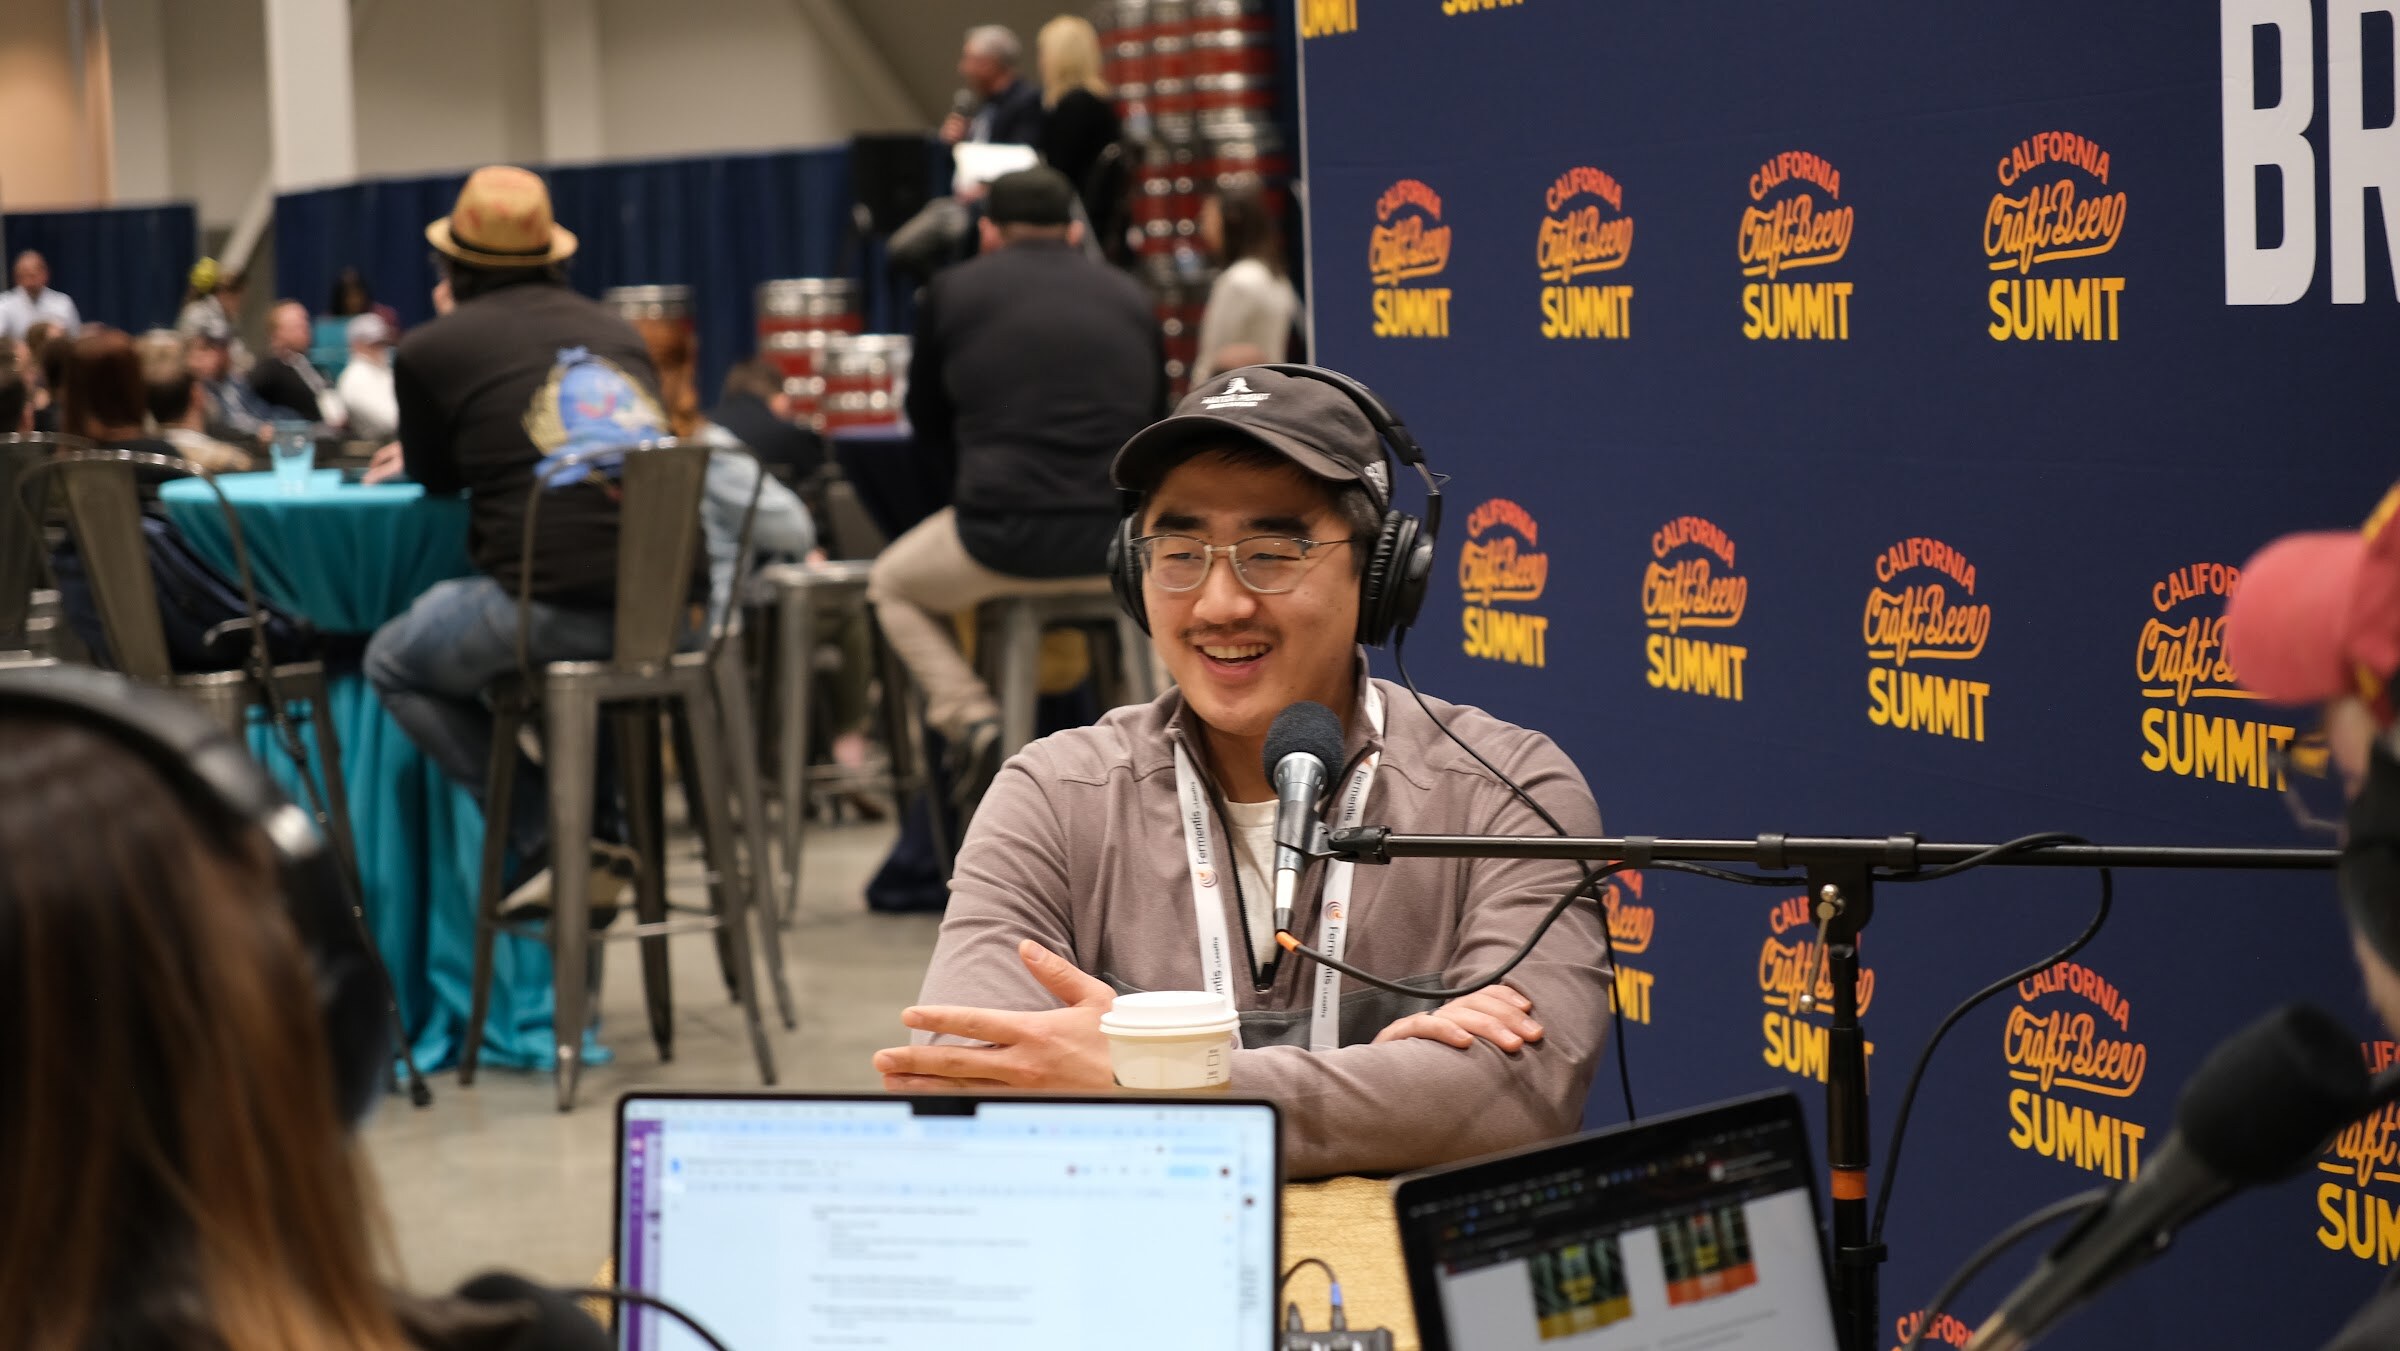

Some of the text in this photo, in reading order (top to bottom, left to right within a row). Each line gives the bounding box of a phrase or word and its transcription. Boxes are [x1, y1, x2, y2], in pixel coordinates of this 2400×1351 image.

[1546, 166, 1622, 212] CALIFORNIA
[1749, 150, 1840, 201] CALIFORNIA
[1997, 130, 2110, 187] CALIFORNIA
[1738, 193, 1854, 280] Craft Beer
[1983, 179, 2126, 275] Craft Beer
[1372, 288, 1452, 338] SUMMIT
[1541, 285, 1634, 339] SUMMIT
[1742, 282, 1853, 340] SUMMIT
[1988, 277, 2126, 341] SUMMIT
[1652, 515, 1735, 569] CALIFORNIA
[1876, 537, 1976, 596] CALIFORNIA
[2152, 562, 2241, 612] CALIFOR
[1462, 605, 1548, 668] SUMMIT
[1863, 584, 1991, 667] Craft Beer
[1646, 633, 1748, 701] SUMMIT
[2136, 616, 2213, 707] Craft
[1868, 666, 1990, 742] SUMMIT
[2141, 707, 2295, 792] SUMMIT
[1323, 926, 1340, 985] Fermtis
[2017, 961, 2130, 1032] CALIFORNIA
[2004, 1005, 2147, 1096] Craft Beer
[2008, 1088, 2146, 1183] SUMMIT
[2316, 1182, 2400, 1266] SUM
